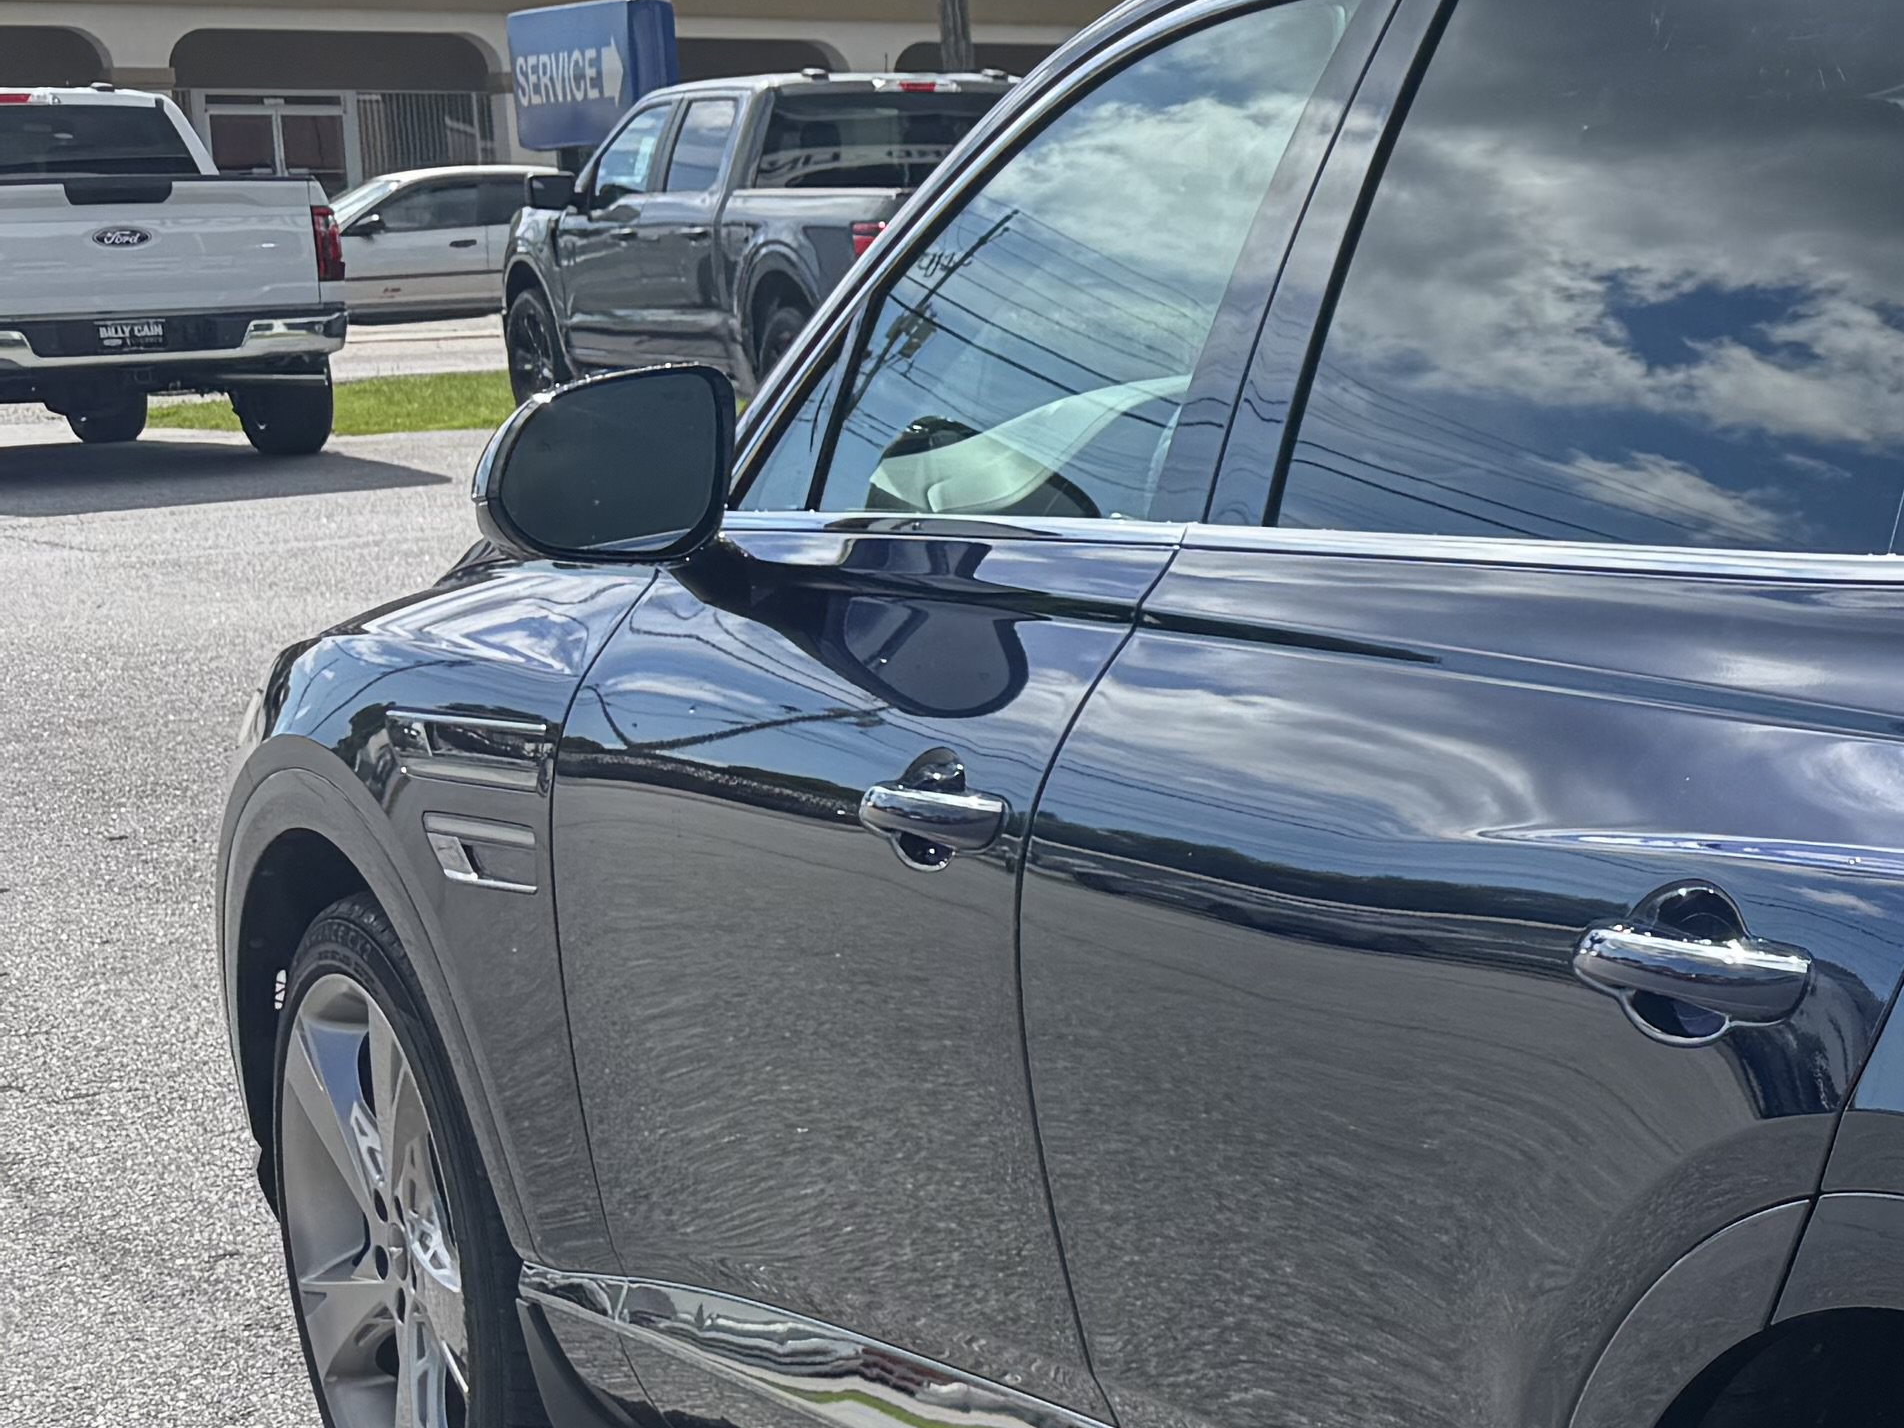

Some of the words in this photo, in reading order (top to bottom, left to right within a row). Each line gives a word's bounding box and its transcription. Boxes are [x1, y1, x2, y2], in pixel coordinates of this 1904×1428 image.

[516, 47, 599, 108] SERVICE
[103, 230, 140, 245] Ford
[99, 325, 131, 339] BILLY
[134, 323, 163, 337] CAIN
